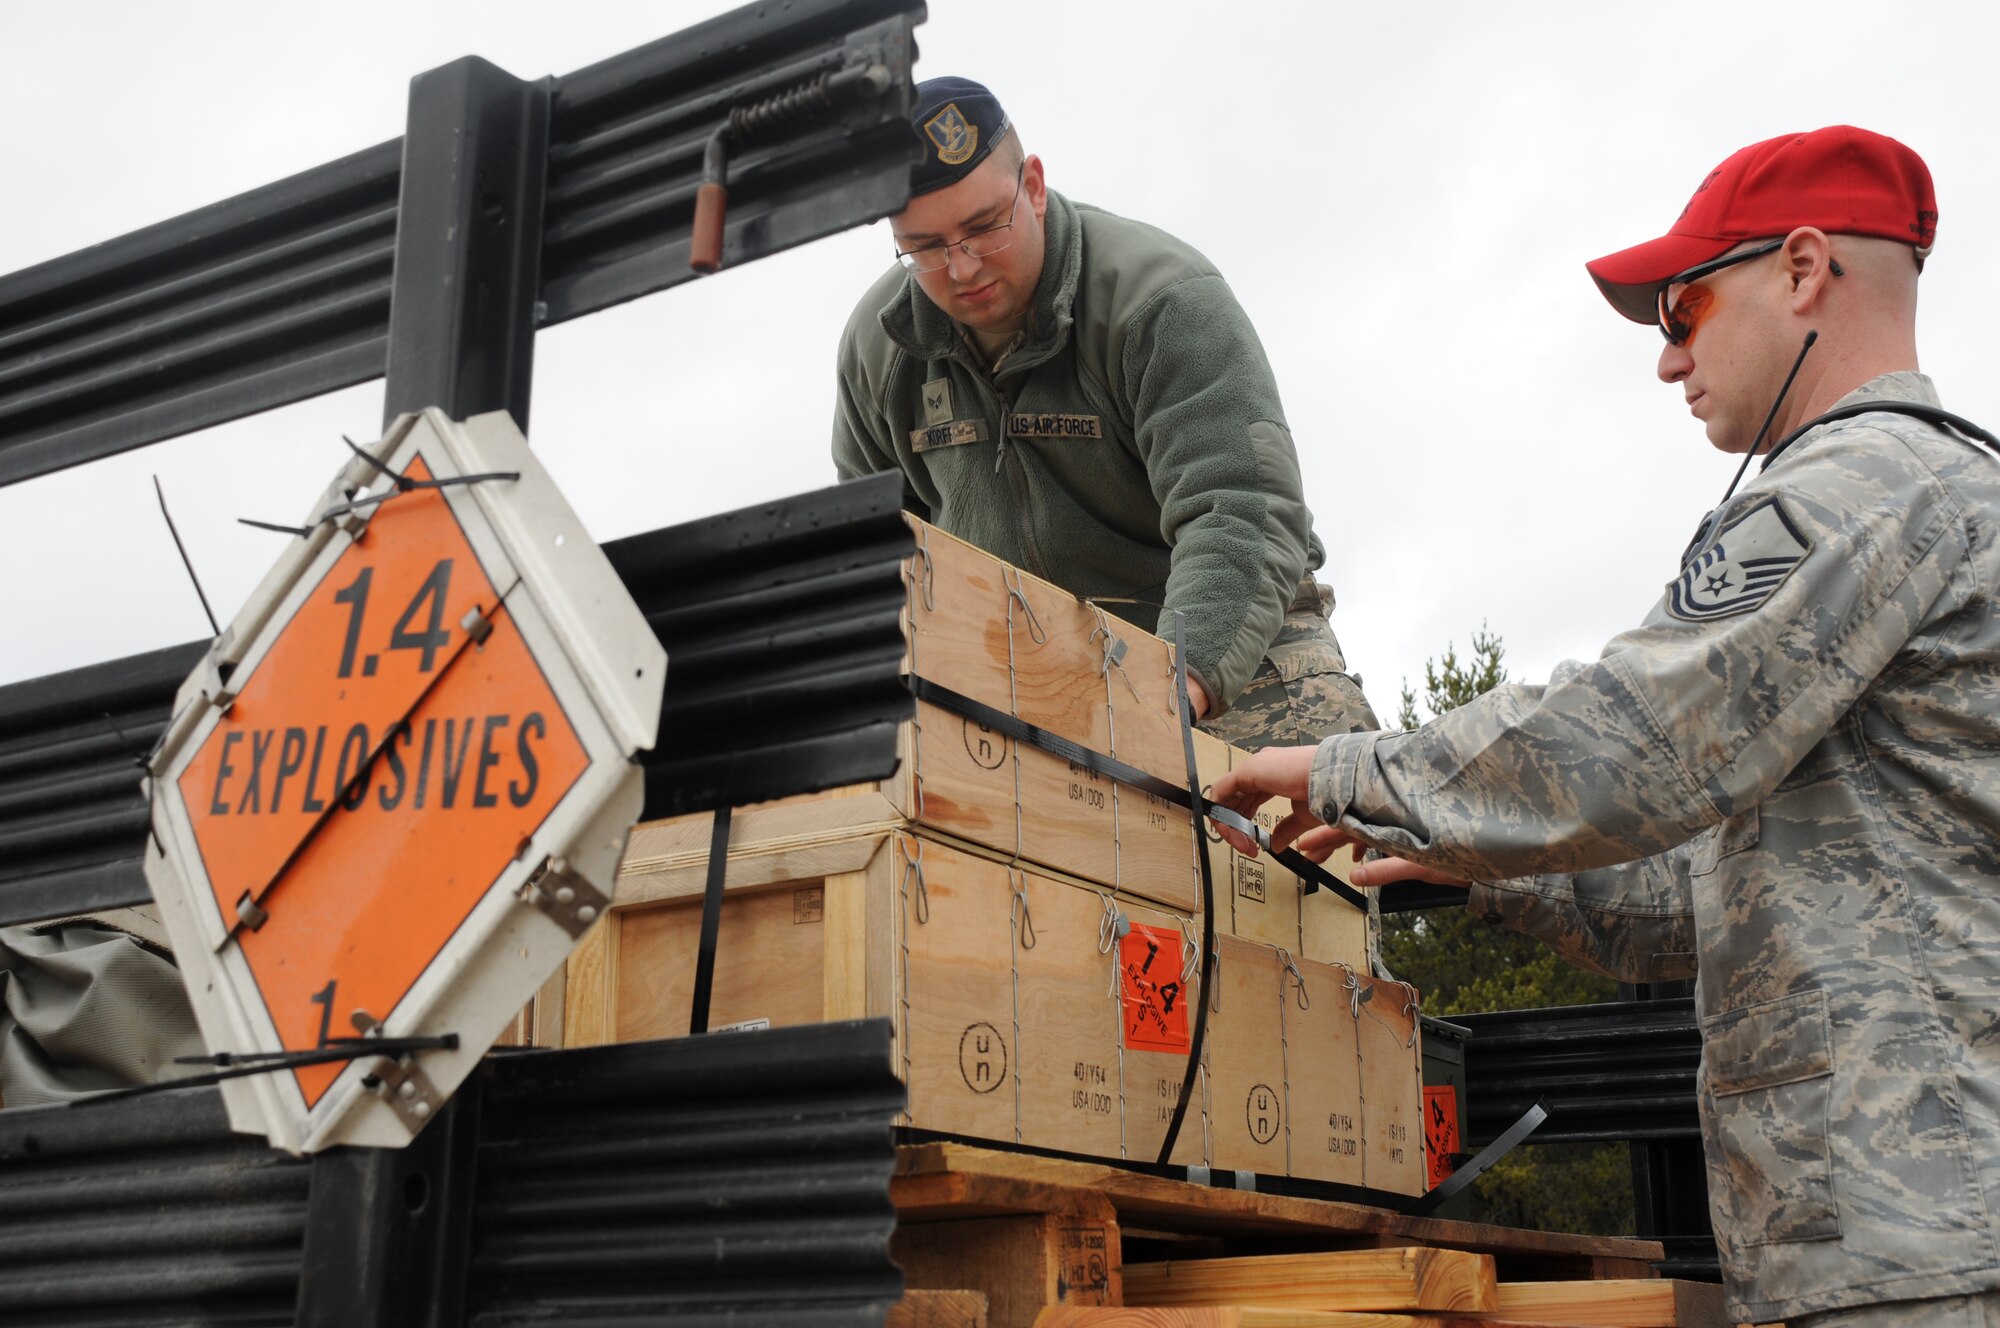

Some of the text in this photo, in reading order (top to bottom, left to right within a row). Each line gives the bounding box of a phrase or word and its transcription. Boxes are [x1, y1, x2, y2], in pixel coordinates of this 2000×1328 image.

[1034, 416, 1054, 434] AIR
[1057, 417, 1096, 436] FORCE
[334, 559, 454, 680] 1.4
[209, 712, 545, 816] EXPLOSIVES
[1069, 783, 1104, 810] USA/DOD
[311, 979, 338, 1050] 1
[1127, 963, 1168, 1038] EXPLOSIVE
[1073, 1090, 1111, 1114] USA/DOD
[1328, 1135, 1357, 1156] USA/DOD
